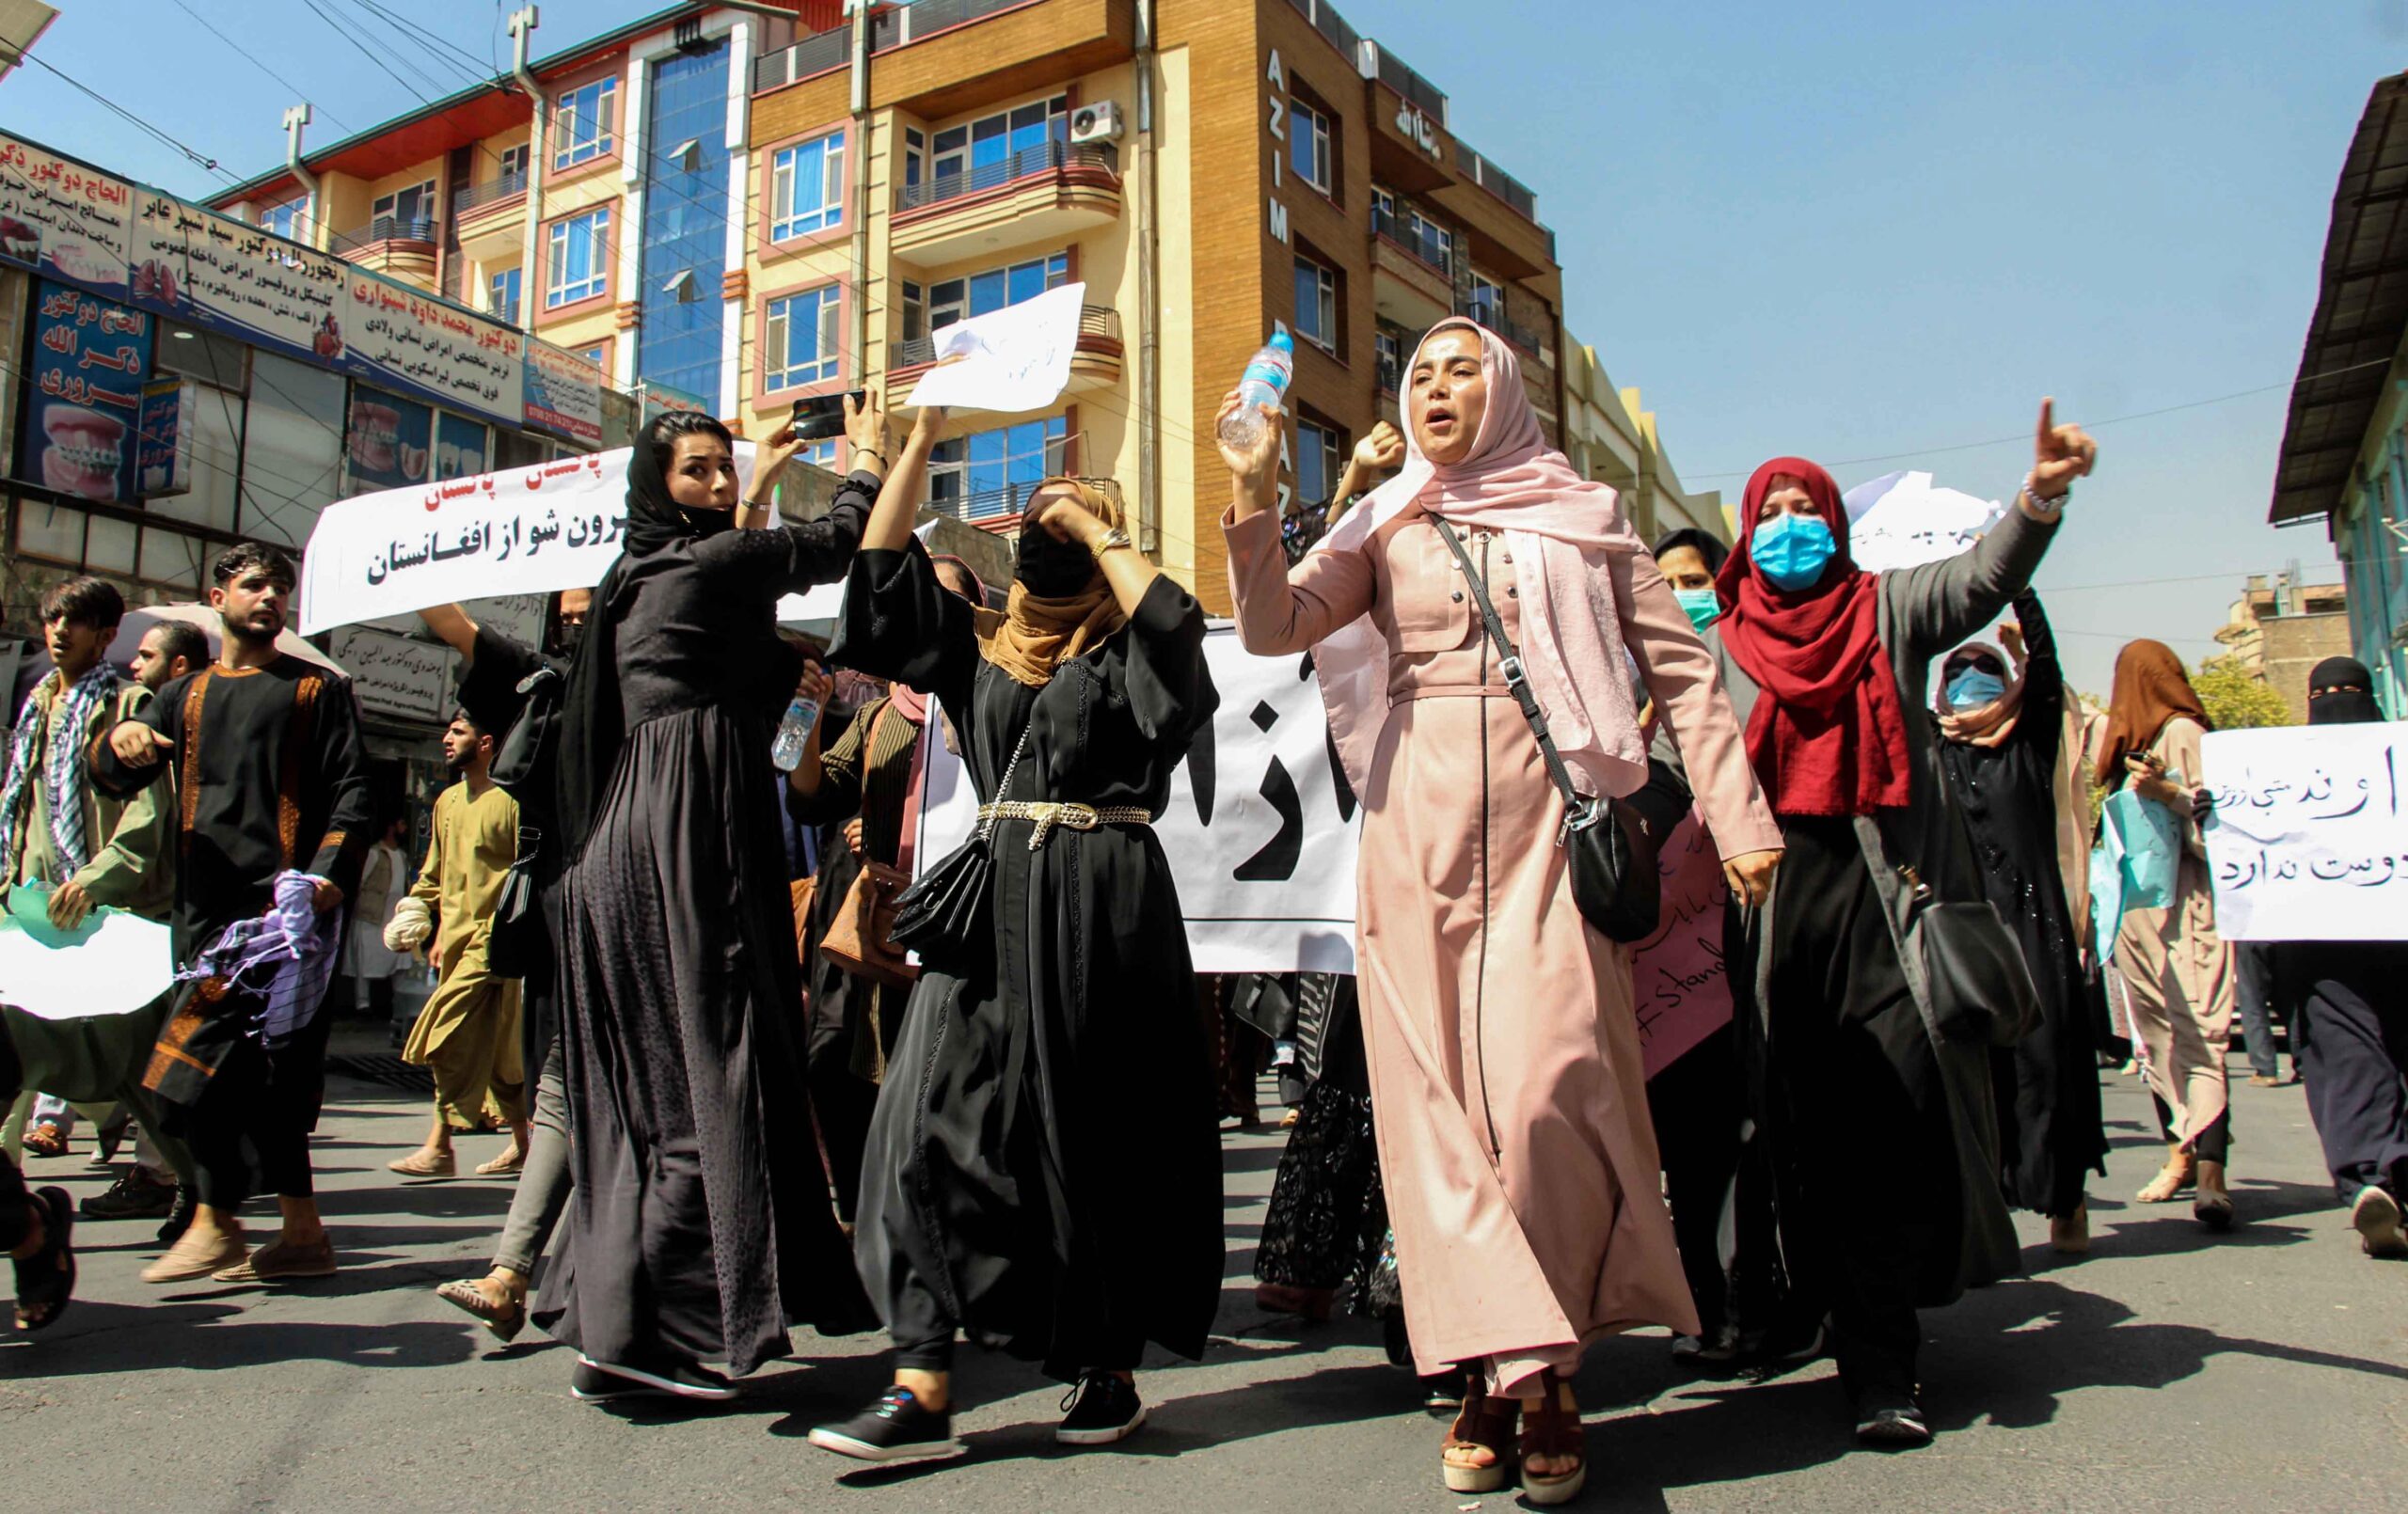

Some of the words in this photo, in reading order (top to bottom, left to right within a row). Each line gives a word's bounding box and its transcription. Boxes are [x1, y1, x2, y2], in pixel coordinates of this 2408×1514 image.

[1267, 49, 1288, 244] AZIM
[86, 177, 126, 206] الحاج
[208, 221, 233, 244] سید
[150, 239, 186, 257] عمومی
[189, 247, 218, 267] داخله
[219, 261, 254, 281] امراض
[100, 306, 146, 338] الحاج
[410, 298, 437, 326] داود
[440, 312, 475, 337] محمد
[41, 323, 78, 356] الله
[365, 318, 393, 339] ولادی
[423, 339, 452, 357] امراض
[453, 352, 489, 370] متخصص
[496, 514, 520, 562] از
[526, 508, 560, 557] شو
[566, 513, 628, 548] رون
[366, 519, 492, 586] افغانستان
